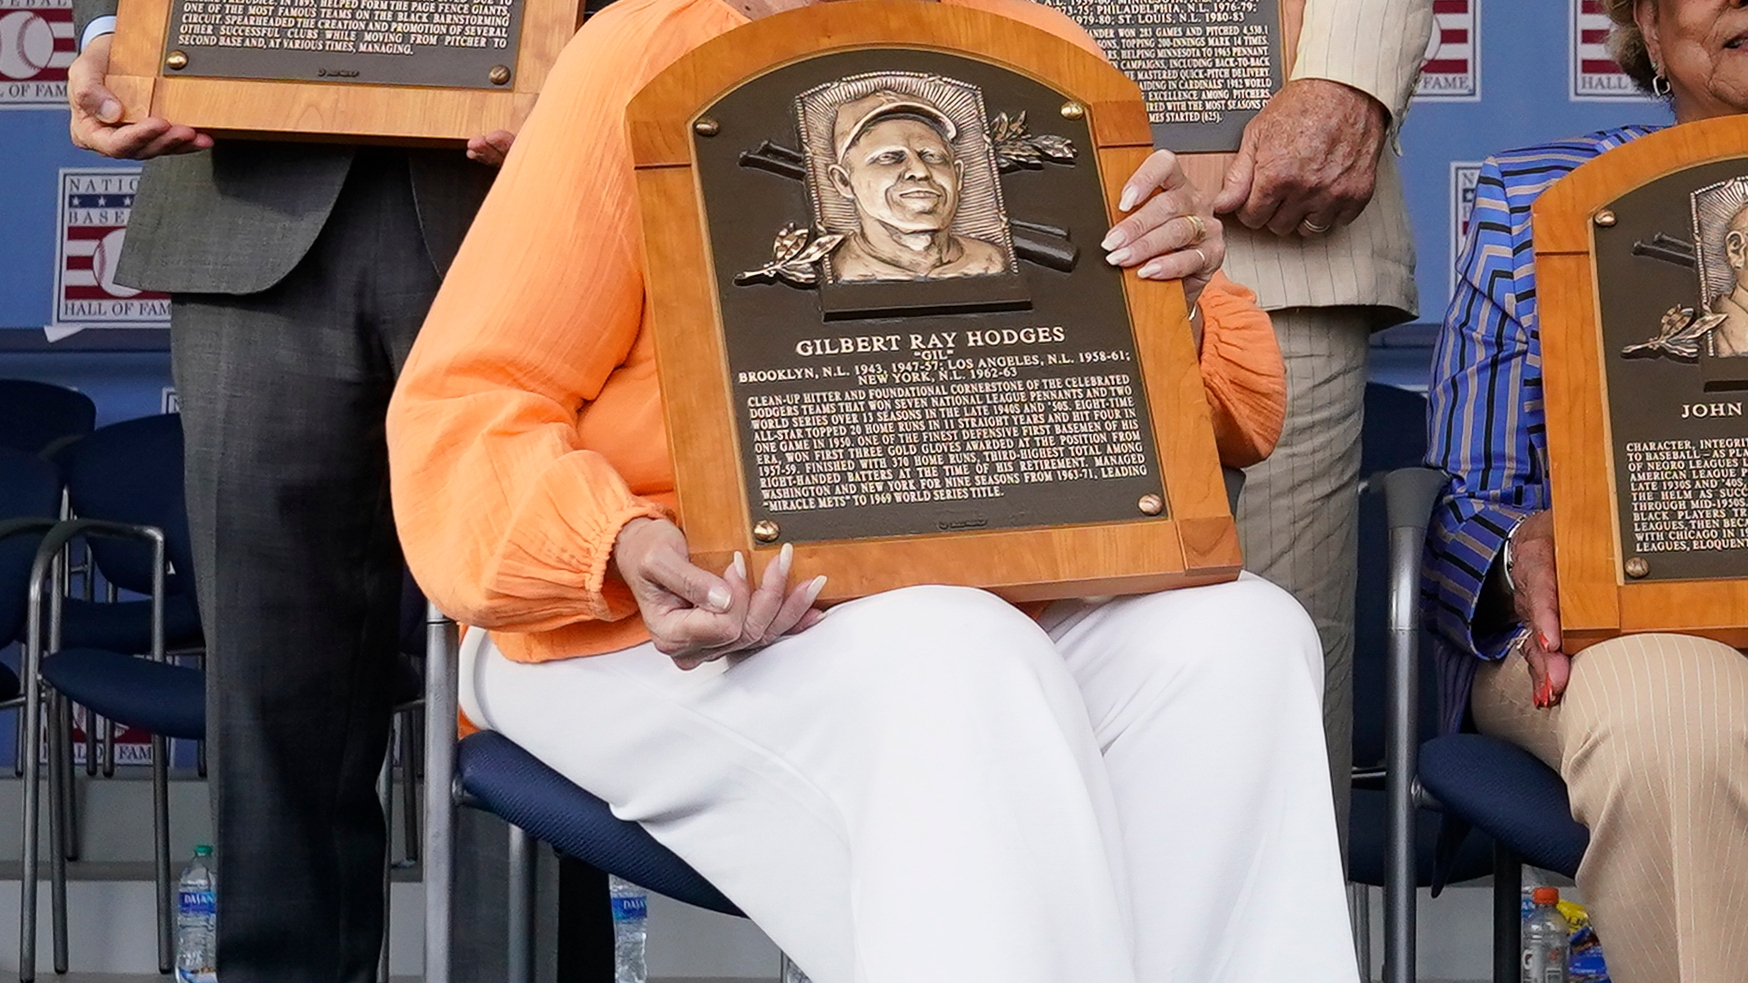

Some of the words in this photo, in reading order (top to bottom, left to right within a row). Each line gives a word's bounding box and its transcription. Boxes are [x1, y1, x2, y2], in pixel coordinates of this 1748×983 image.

[1205, 13, 1244, 23] 1980-83
[178, 36, 217, 47] SECOND
[218, 38, 241, 48] BASE
[268, 40, 279, 50] AT
[283, 40, 323, 52] VARIOUS
[1423, 75, 1469, 90] FAME
[9, 84, 31, 98] OF
[35, 84, 68, 98] FAM
[70, 178, 140, 193] NATIO
[69, 210, 126, 224] BASE
[64, 302, 108, 316] HALL
[112, 302, 134, 316] OF
[139, 302, 171, 316] FAM
[796, 334, 900, 356] GILBERT
[910, 331, 955, 351] RAY
[967, 326, 1065, 348] HODGES
[739, 367, 819, 383] BROOKLYN,
[892, 360, 944, 375] 1947-57;
[948, 359, 973, 372] LOS
[978, 355, 1044, 370] ANGELES,
[1079, 350, 1131, 365] 1958-61;
[858, 373, 888, 385] NEW
[970, 366, 1017, 380] 1962-63
[1681, 401, 1741, 419] JOHN
[853, 495, 867, 506] TO
[870, 493, 891, 505] 1969
[894, 491, 931, 504] WORLD
[933, 489, 968, 501] SERIES
[118, 744, 151, 761] FAM
